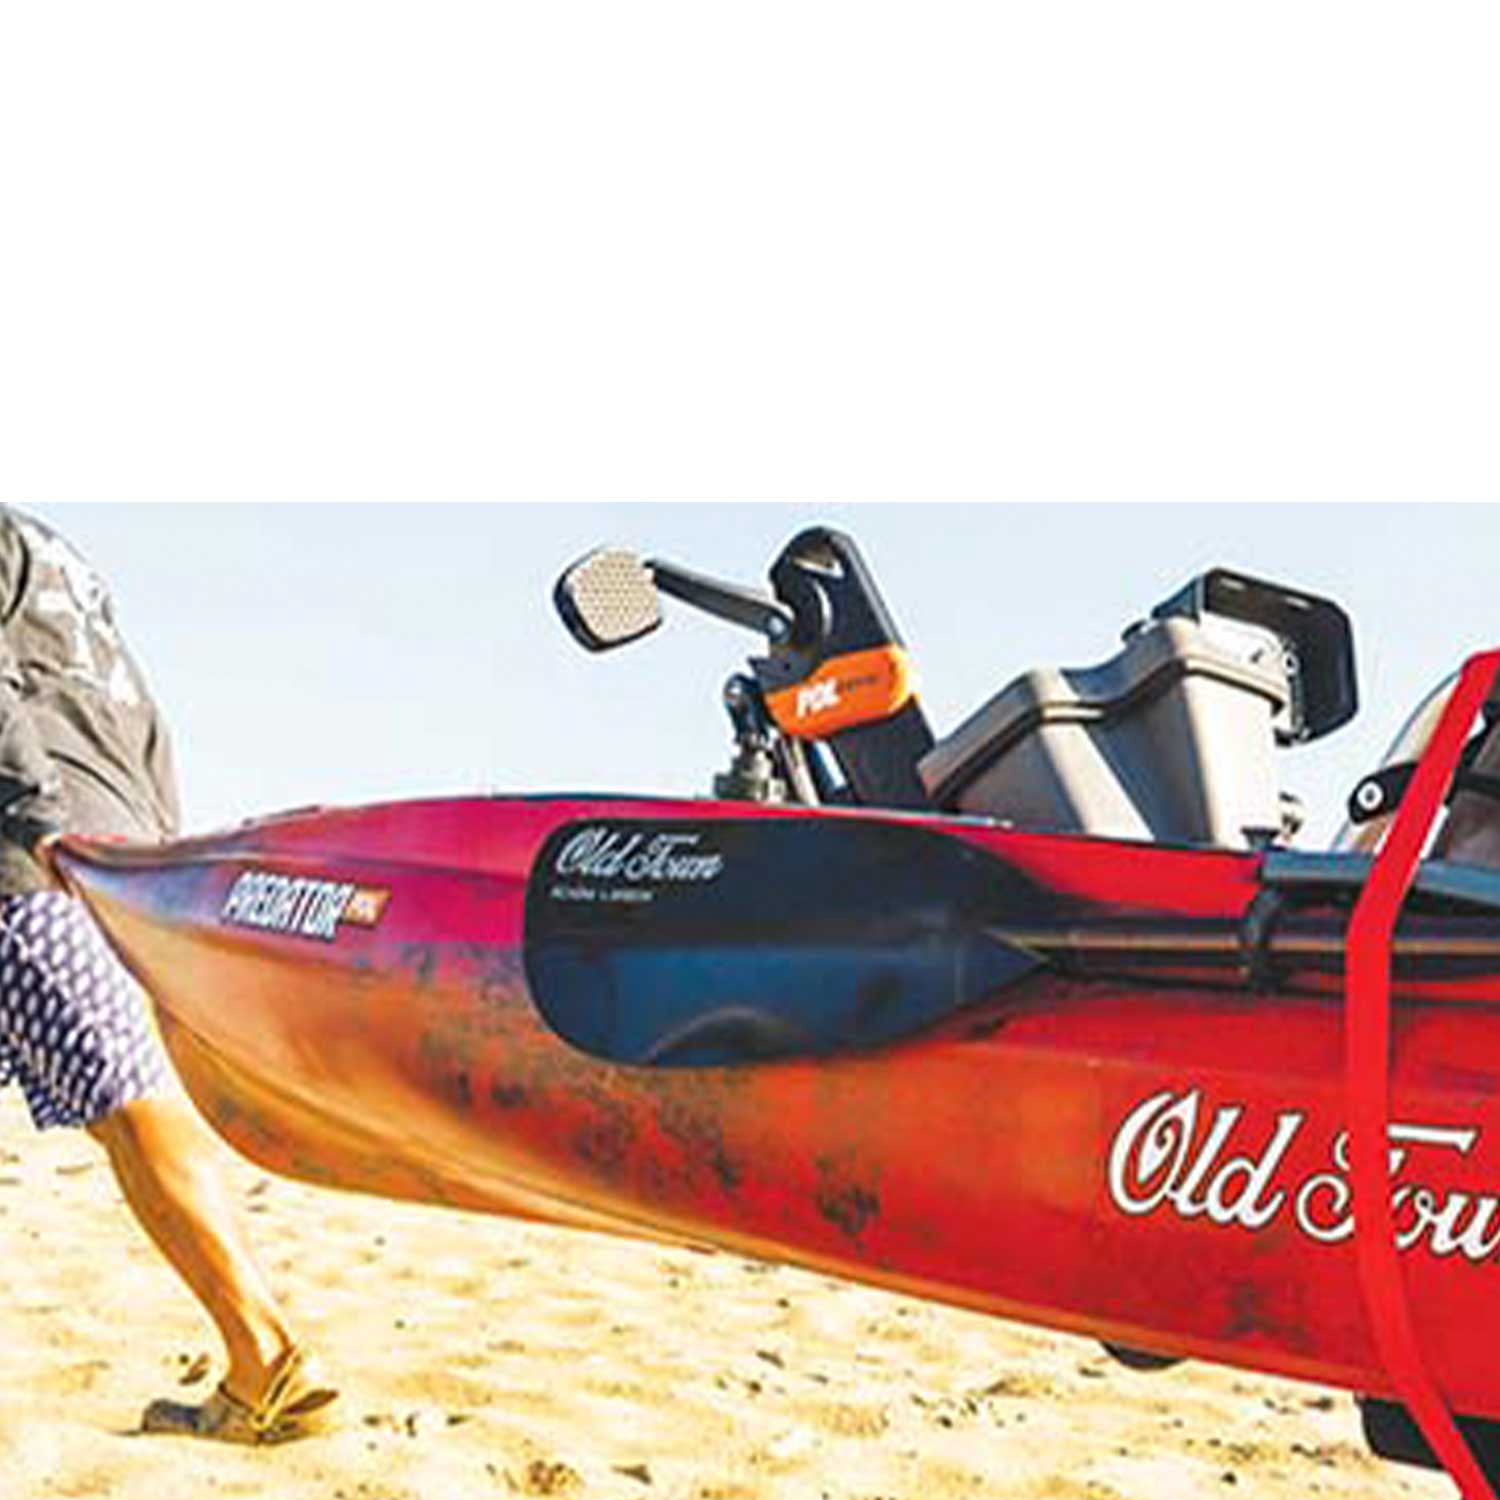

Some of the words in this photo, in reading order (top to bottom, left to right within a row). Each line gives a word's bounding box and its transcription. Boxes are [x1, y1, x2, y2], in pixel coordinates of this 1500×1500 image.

[556, 826, 642, 876] Old
[623, 833, 724, 881] Town
[221, 870, 356, 938] PREDATOR
[1107, 1088, 1304, 1230] Old
